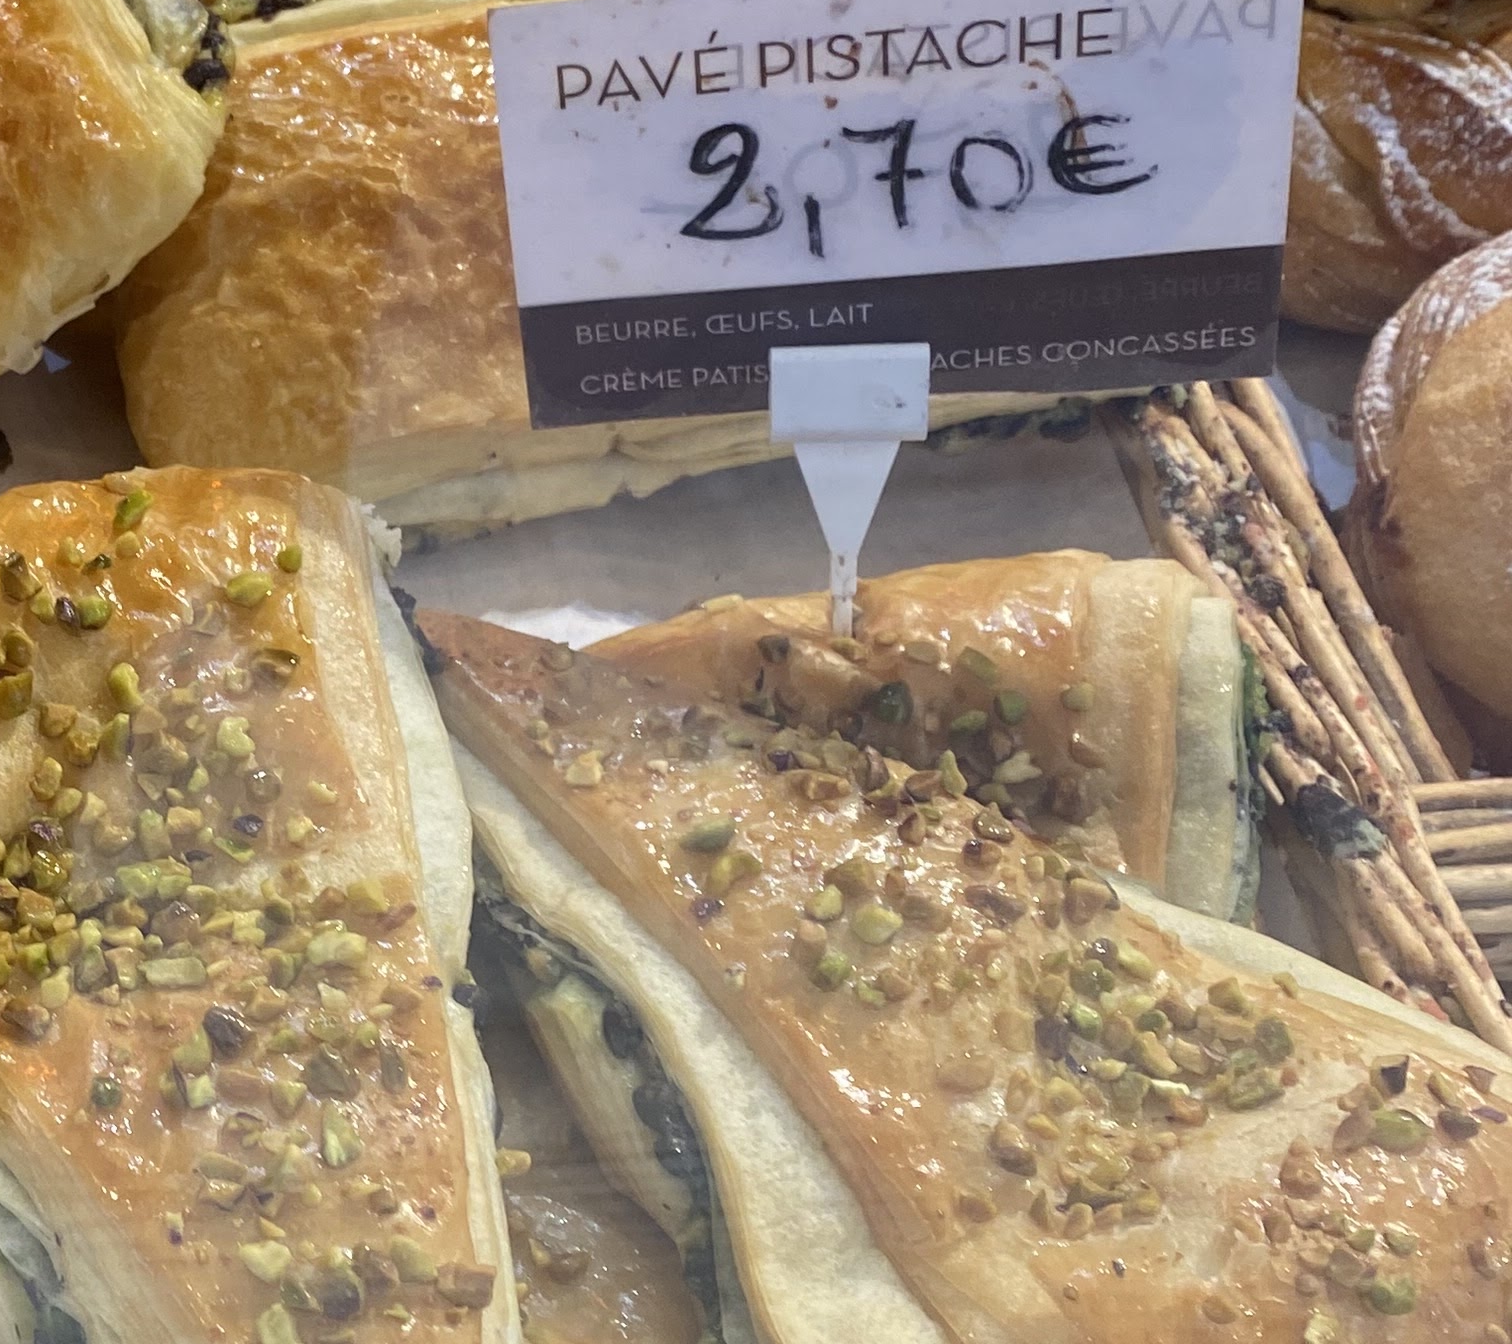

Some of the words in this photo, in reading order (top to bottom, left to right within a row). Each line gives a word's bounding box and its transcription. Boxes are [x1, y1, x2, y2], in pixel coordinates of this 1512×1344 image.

[557, 29, 732, 110] PAVÉ
[759, 7, 1114, 88] PISTACHE
[575, 317, 697, 345] BEURRE,
[705, 309, 801, 336] ŒUFS,
[809, 303, 874, 328] LAIT
[580, 367, 683, 395] CRÈME
[1041, 321, 1257, 364] CONCASSÉES
